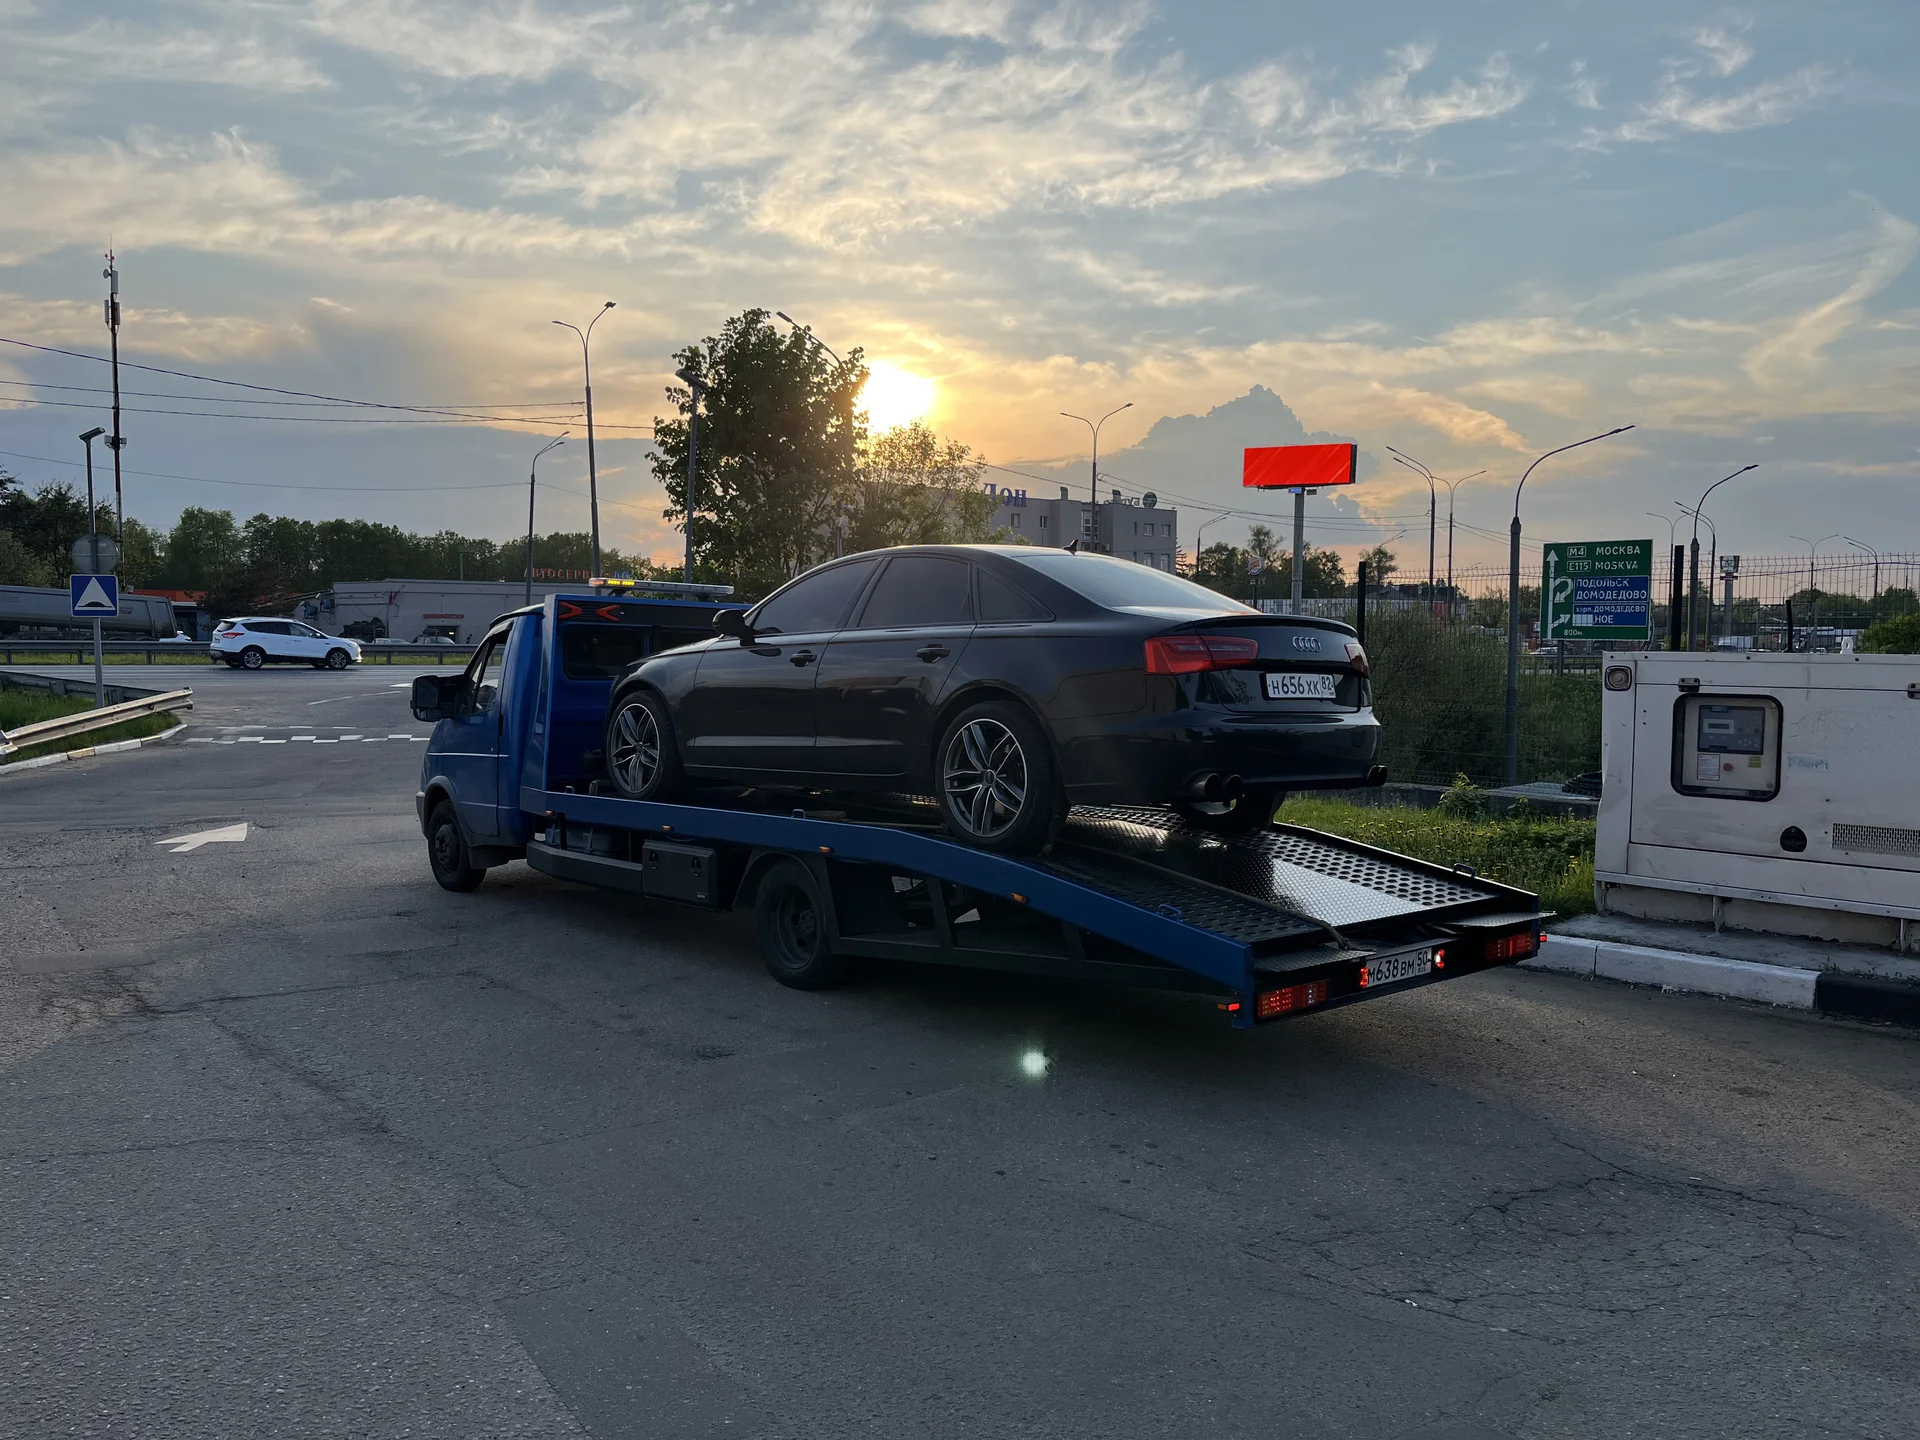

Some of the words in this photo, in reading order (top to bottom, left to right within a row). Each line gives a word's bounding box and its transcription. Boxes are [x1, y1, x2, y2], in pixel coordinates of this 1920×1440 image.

[1596, 546, 1640, 555] МОСКВА
[1569, 562, 1589, 571] E115
[1595, 560, 1638, 570] MOSKVA
[1576, 578, 1629, 588] ПОДОЛЬСК
[1576, 590, 1647, 600] ДОМОДЕДОВО
[1593, 605, 1646, 613] ДОМОДЕДОВО
[1321, 676, 1331, 690] 82
[1416, 951, 1428, 967] 50
